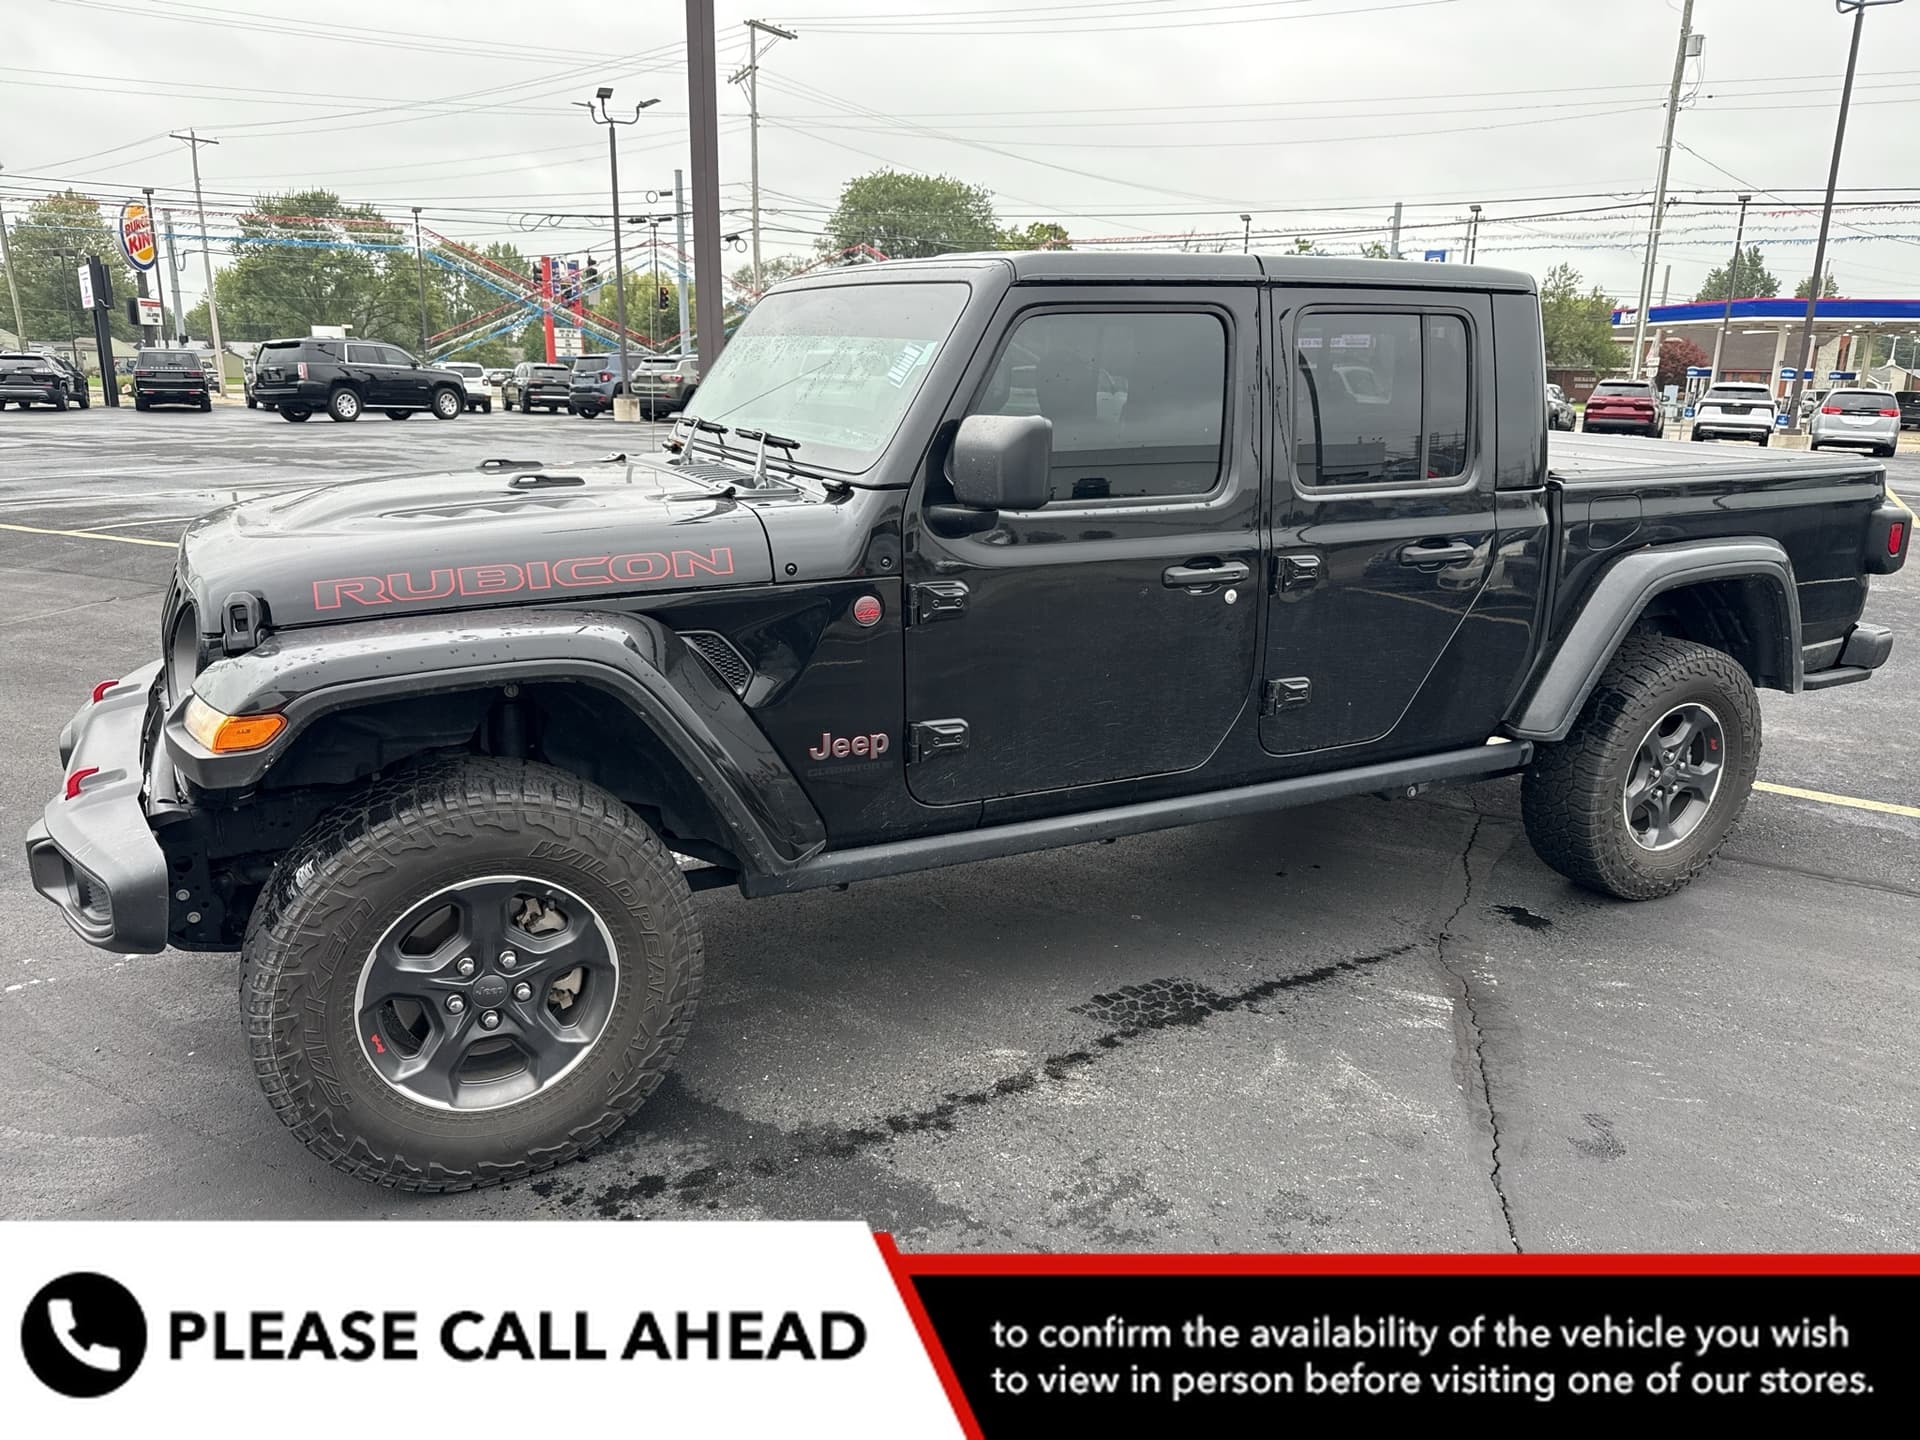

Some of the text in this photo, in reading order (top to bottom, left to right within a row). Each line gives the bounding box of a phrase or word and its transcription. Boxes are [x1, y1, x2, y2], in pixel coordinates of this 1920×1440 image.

[129, 233, 151, 255] KIN
[313, 547, 734, 610] RUBICON
[809, 732, 889, 760] Jeep
[528, 841, 667, 1015] WILDPEAK
[302, 897, 378, 1112] FALKEN
